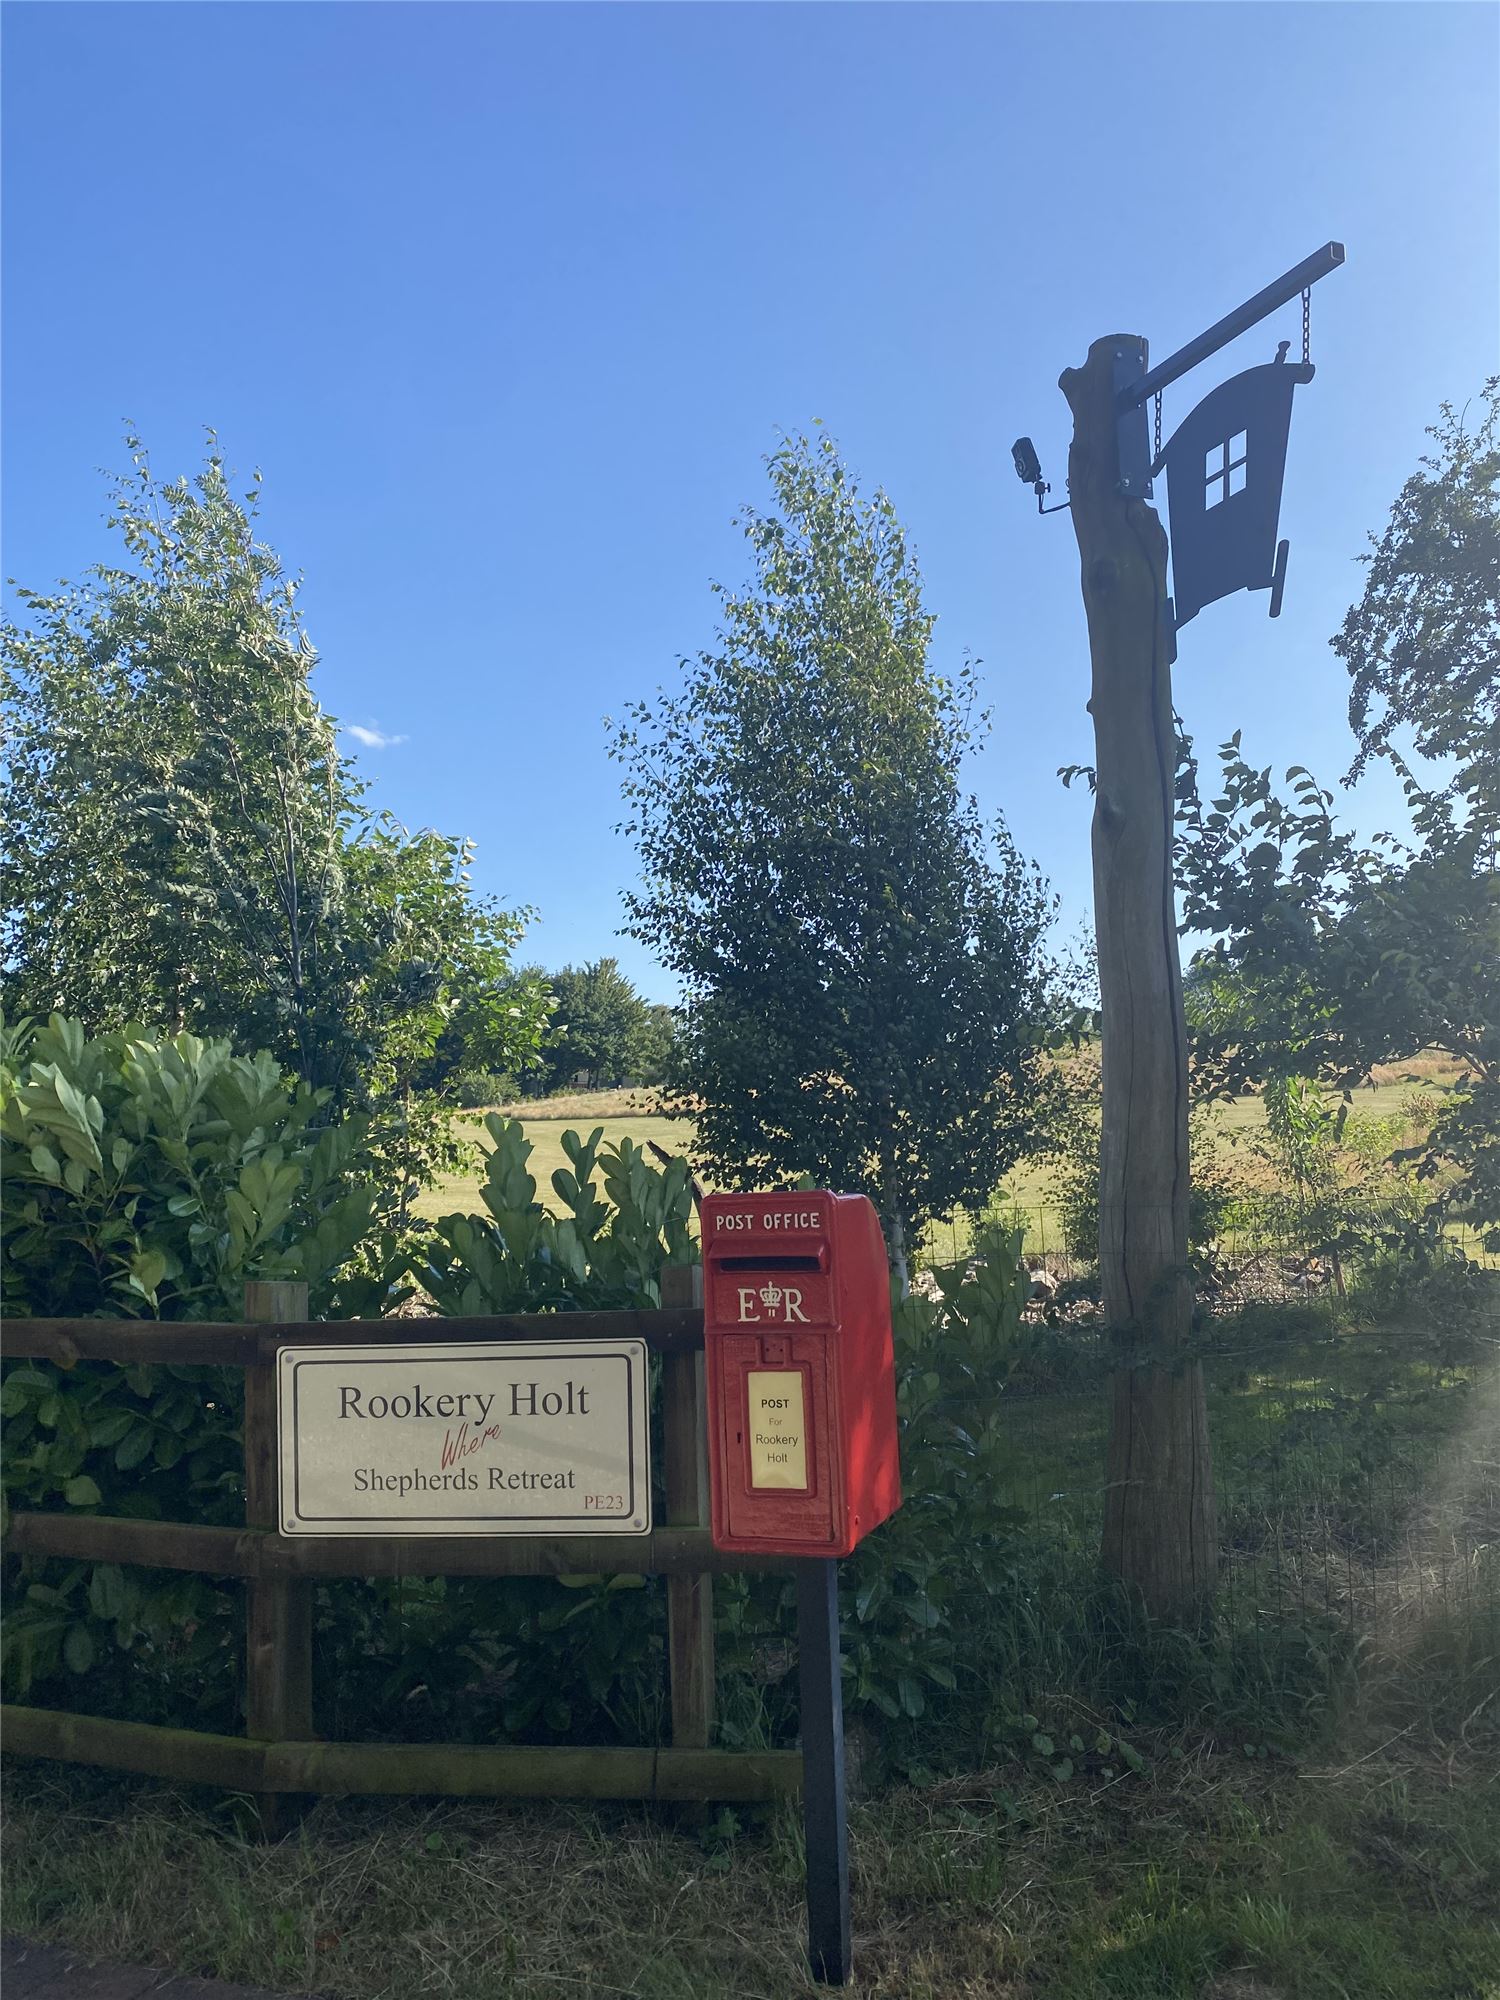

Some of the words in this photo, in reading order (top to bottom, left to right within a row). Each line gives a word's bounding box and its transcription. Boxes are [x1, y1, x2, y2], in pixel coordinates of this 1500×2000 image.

[716, 1214, 754, 1231] POST
[763, 1212, 821, 1230] OFFICE
[337, 1384, 496, 1427] Rookery
[507, 1381, 591, 1417] Holt
[761, 1398, 790, 1409] POST
[768, 1417, 783, 1427] For
[441, 1421, 502, 1471] Where
[755, 1433, 799, 1448] Rookery
[767, 1452, 788, 1464] Holt
[353, 1467, 479, 1497] Shepherds
[488, 1467, 576, 1490] Retreat
[583, 1494, 625, 1511] PE23
